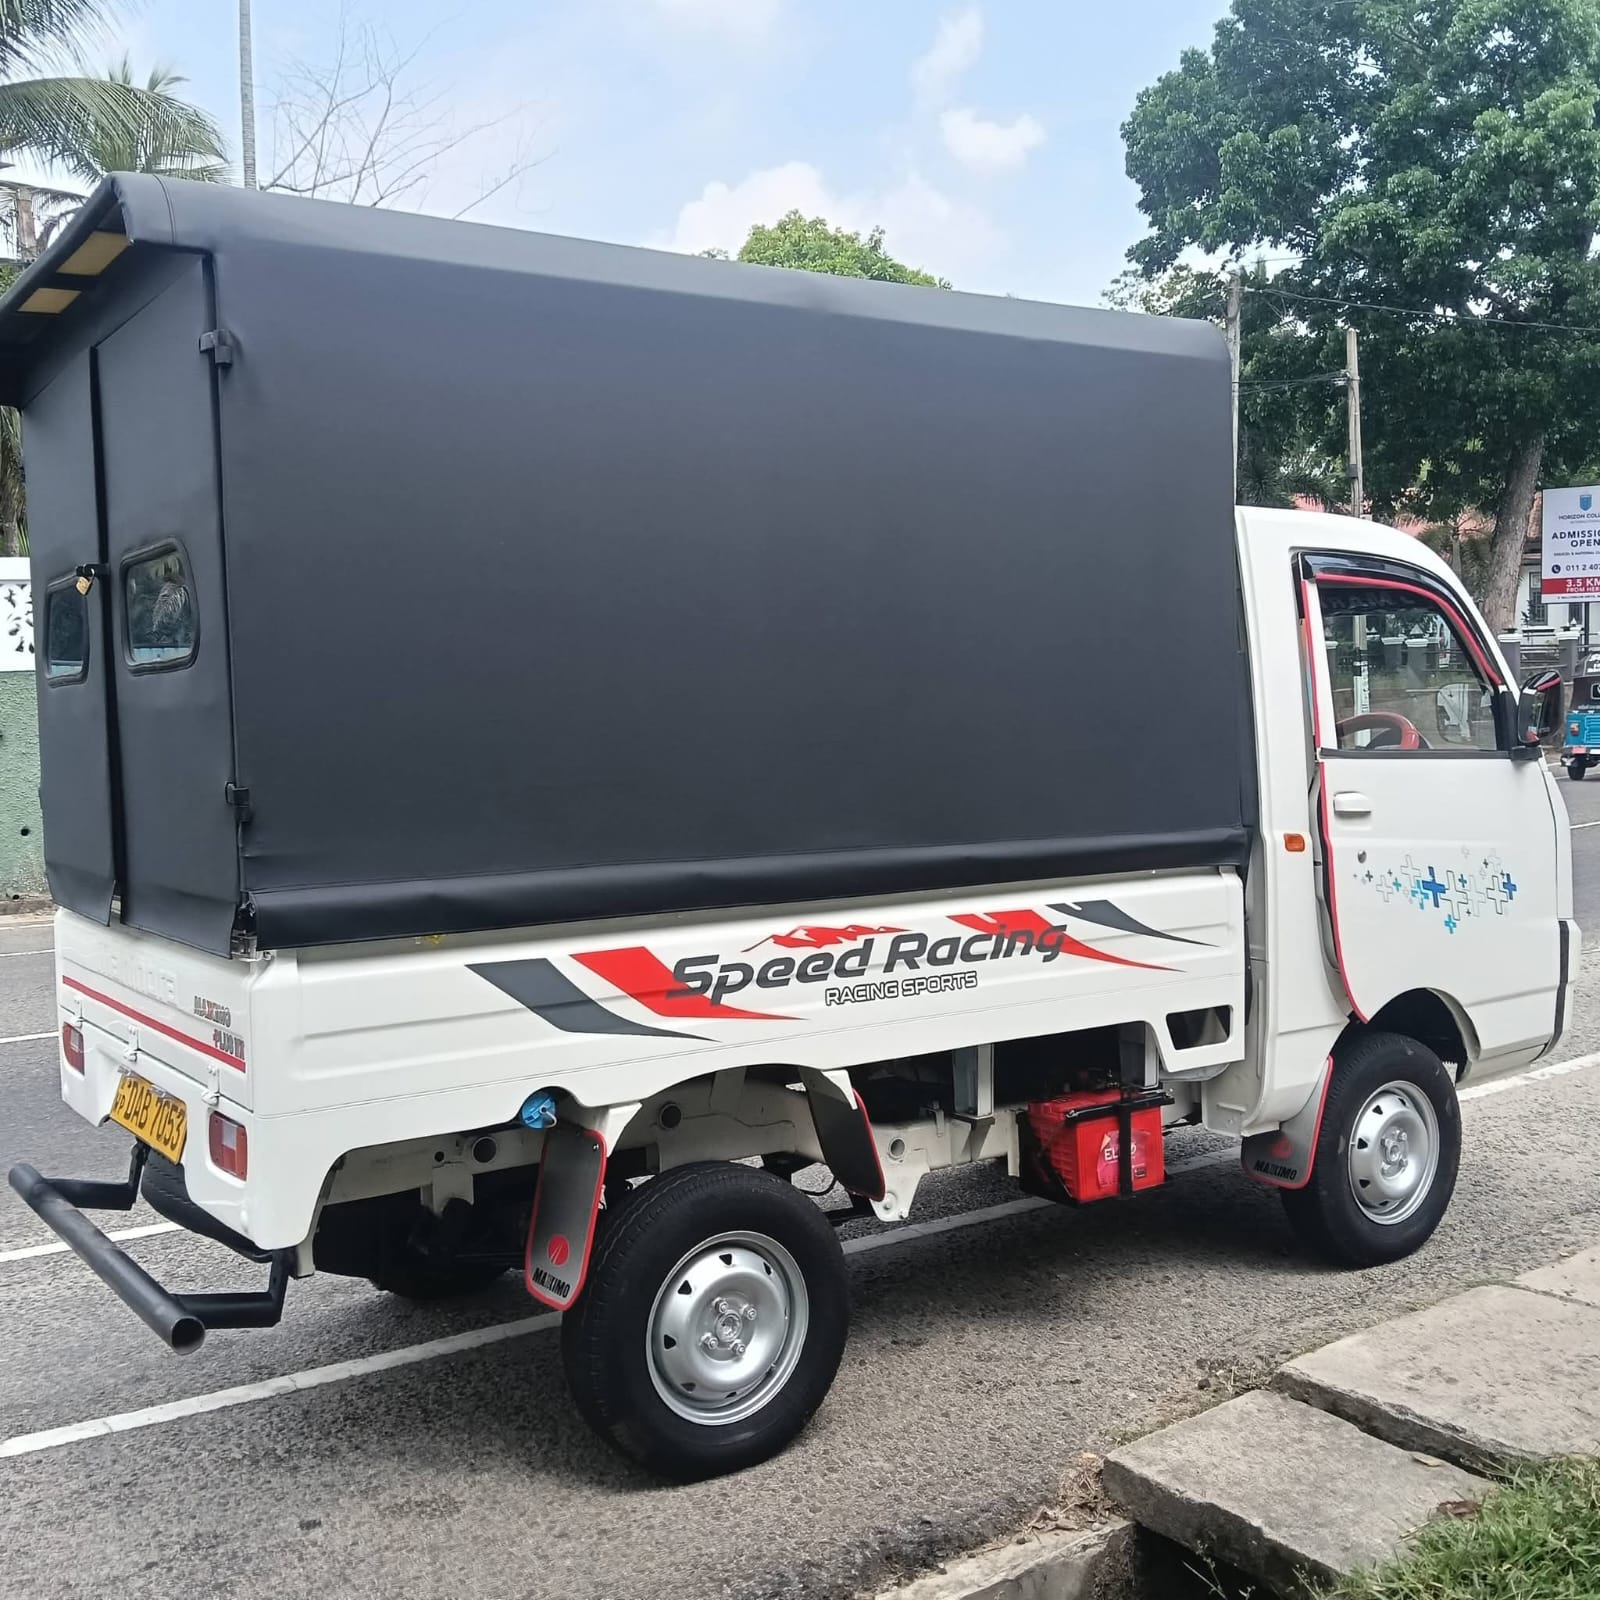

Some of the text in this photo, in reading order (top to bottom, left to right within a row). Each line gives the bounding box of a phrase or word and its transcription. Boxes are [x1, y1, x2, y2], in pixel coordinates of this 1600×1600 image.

[1570, 539, 1600, 548] OPEN
[1581, 563, 1587, 571] 2
[1566, 578, 1583, 588] 3.5
[666, 924, 1068, 1007] Speed Racing
[825, 971, 978, 1006] RACING SPORTS
[150, 1096, 187, 1152] 7053
